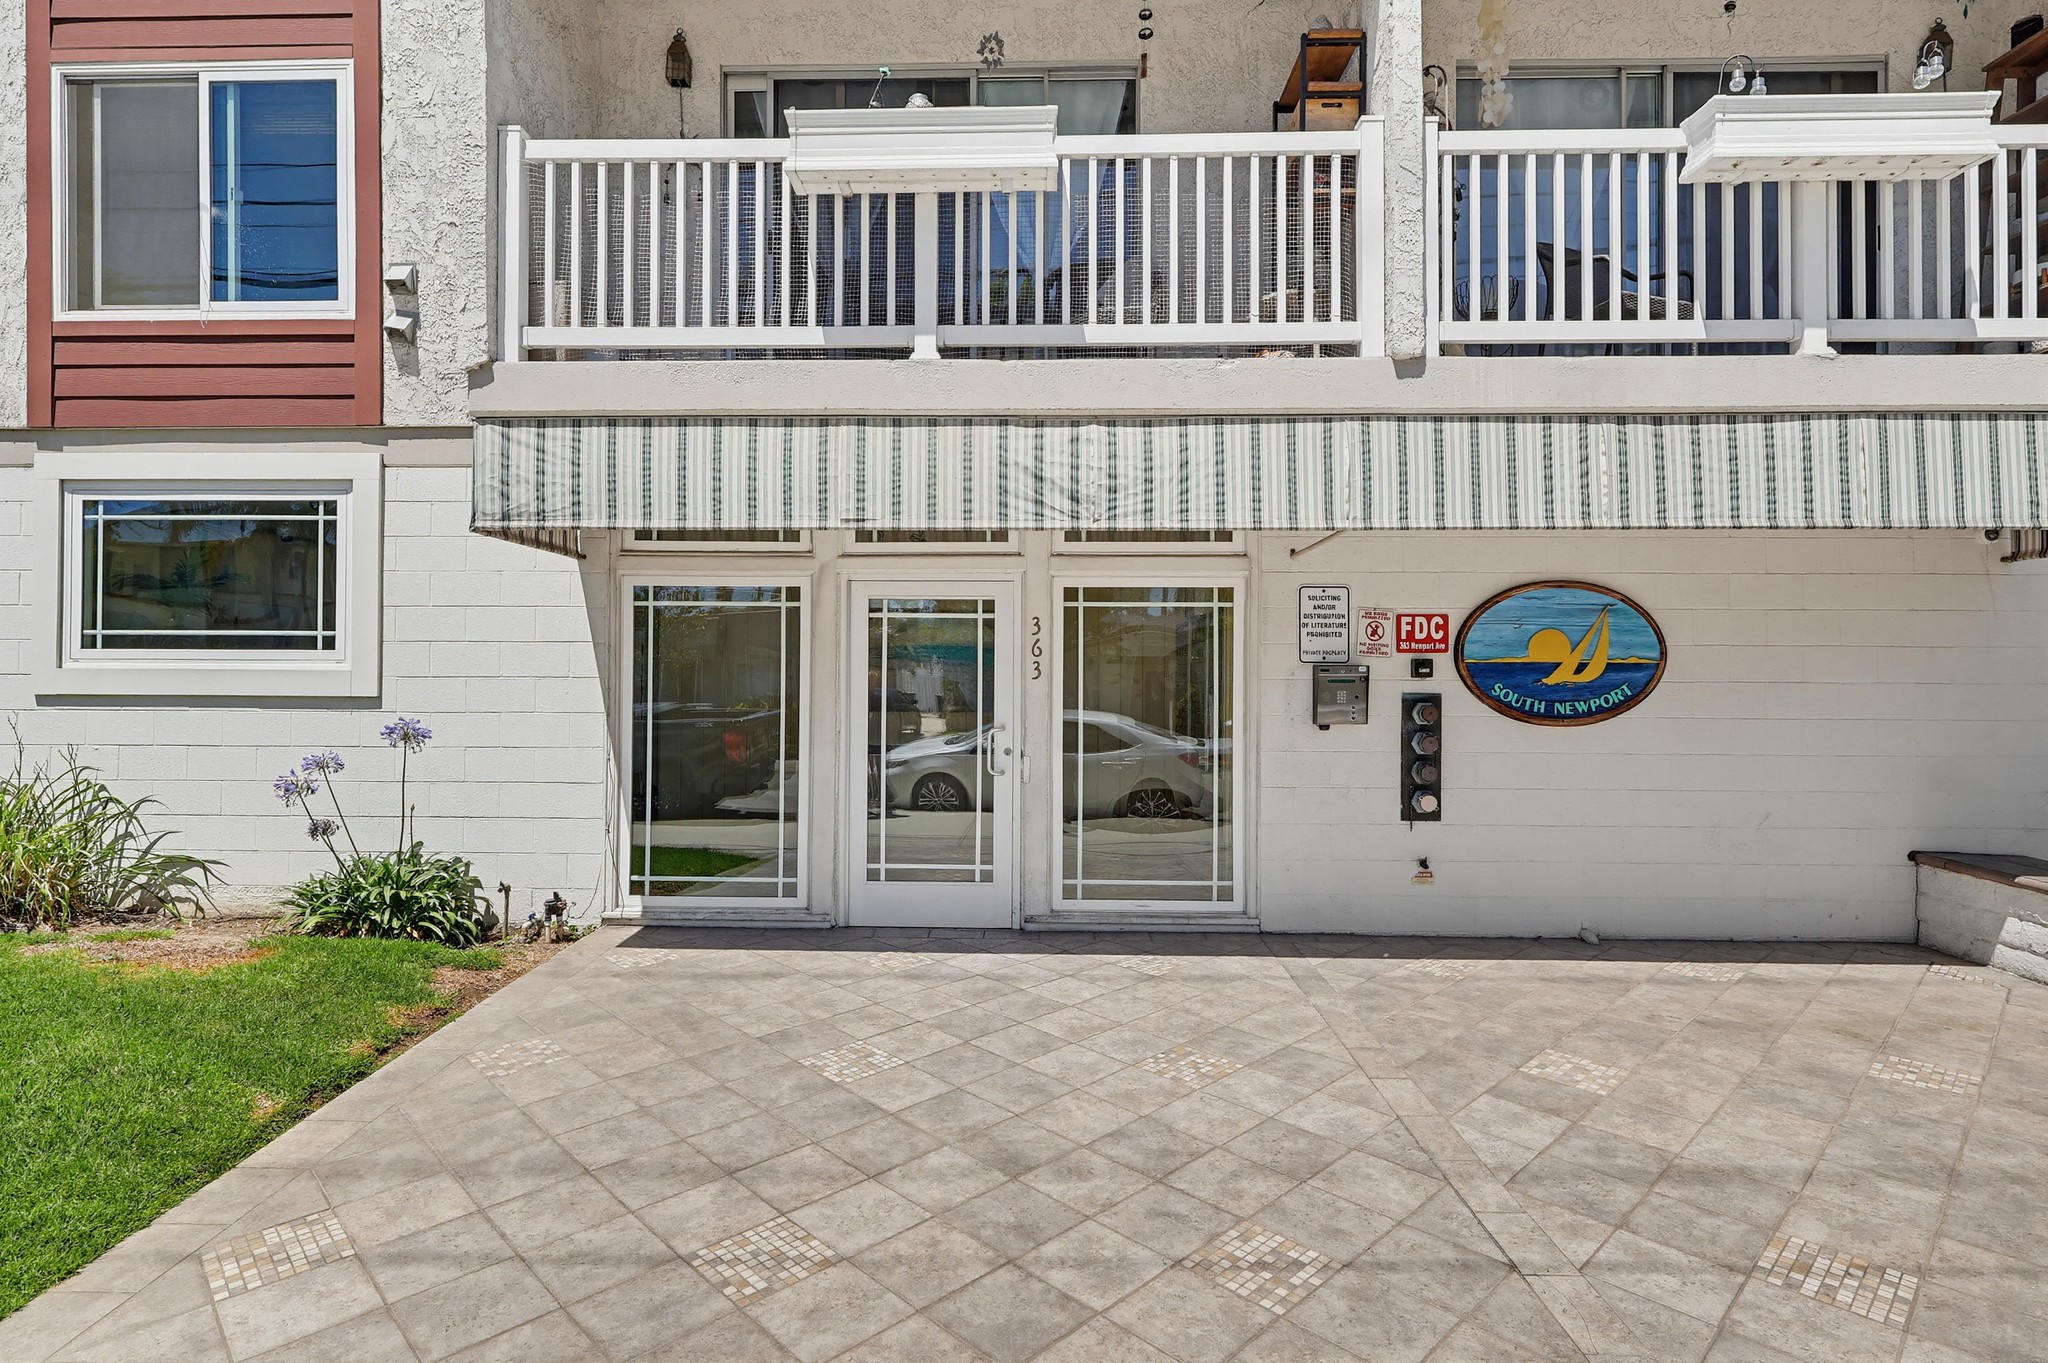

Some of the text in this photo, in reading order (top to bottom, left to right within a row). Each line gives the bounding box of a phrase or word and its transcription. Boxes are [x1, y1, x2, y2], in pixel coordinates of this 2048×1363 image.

[1401, 616, 1444, 640] FDC
[1032, 616, 1042, 680] 363
[1411, 641, 1434, 651] Newport
[1491, 682, 1633, 715] SOUTH NEWPORT
